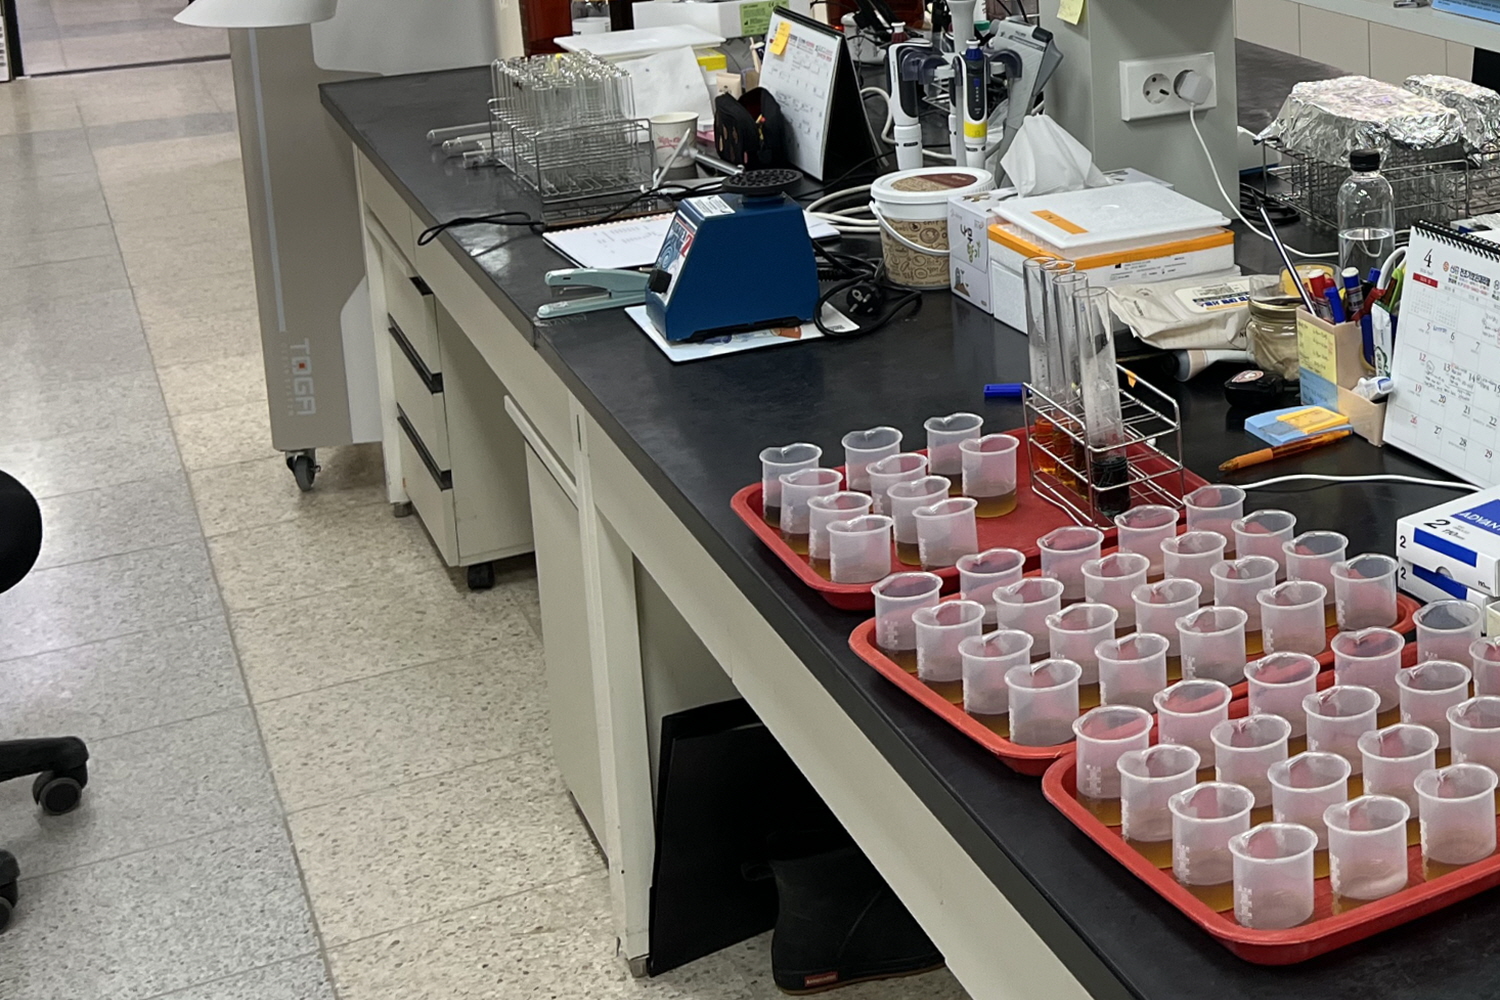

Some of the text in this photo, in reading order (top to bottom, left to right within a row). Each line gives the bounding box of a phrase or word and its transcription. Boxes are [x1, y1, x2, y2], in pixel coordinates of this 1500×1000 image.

[1423, 248, 1433, 268] 4
[1426, 322, 1431, 332] 5
[1450, 331, 1455, 341] 6
[1475, 341, 1480, 351] 7
[1419, 353, 1426, 362] 12
[1443, 363, 1451, 373] 13
[1468, 372, 1476, 383] 14
[1493, 382, 1500, 394] 15
[1415, 384, 1422, 393] 19
[1438, 394, 1447, 404] 20
[1463, 405, 1471, 415] 21
[1489, 416, 1498, 426] 22
[1410, 415, 1418, 425] 26
[1434, 426, 1442, 435] 27
[1459, 437, 1467, 447] 28
[1484, 449, 1493, 459] 29
[1424, 519, 1441, 529] 2
[1399, 535, 1407, 549] 2
[1400, 566, 1407, 580] 2
